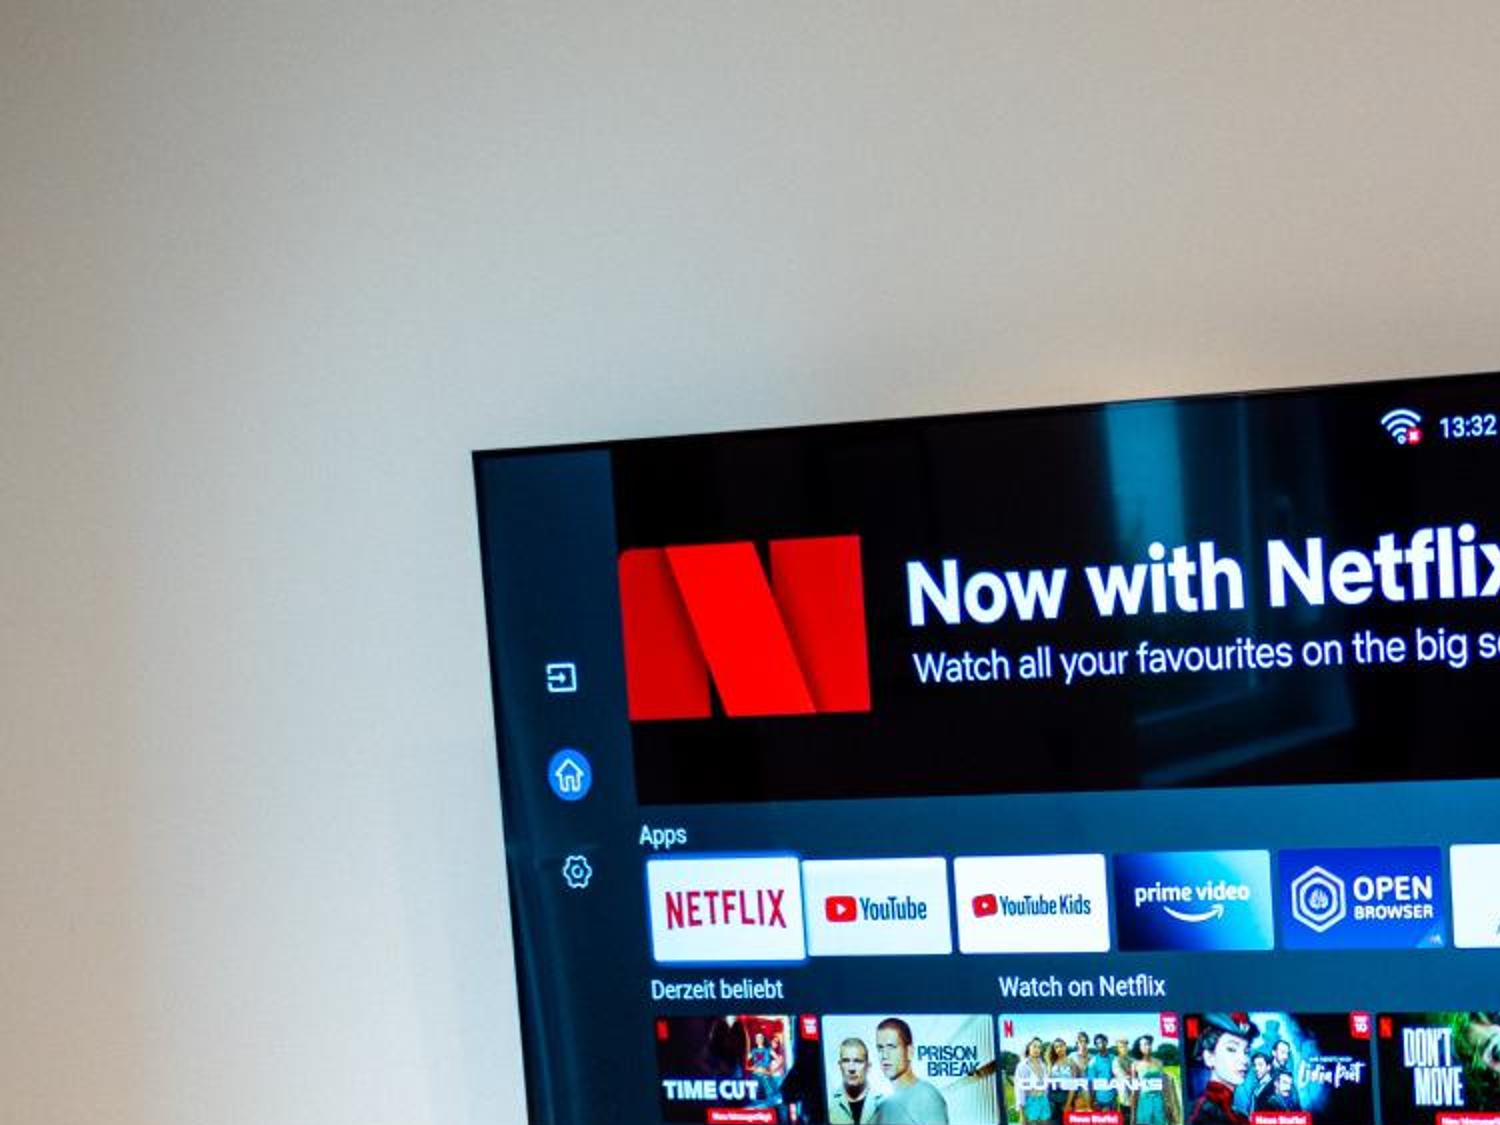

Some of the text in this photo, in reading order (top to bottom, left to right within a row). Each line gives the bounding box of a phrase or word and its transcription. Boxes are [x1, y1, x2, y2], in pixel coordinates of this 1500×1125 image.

[1440, 414, 1497, 439] 13:32
[906, 559, 1066, 627] Now
[1085, 541, 1245, 617] with
[912, 649, 1010, 683] Watch
[1018, 647, 1052, 679] all
[1060, 650, 1128, 685] your
[1136, 640, 1293, 674] favourites
[1302, 641, 1343, 666] on
[1352, 630, 1406, 663] the
[1415, 628, 1468, 668] big
[640, 825, 687, 848] Apps
[1134, 881, 1250, 907] prime video
[1353, 876, 1433, 901] OPEN
[665, 889, 788, 930] NETFLIX
[860, 896, 928, 921] YouTube
[1000, 893, 1091, 917] YouTube Kids
[1353, 904, 1434, 920] BROWSER
[651, 977, 785, 1000] Derzeit beliebt
[999, 974, 1166, 997] Watch on Netflix
[917, 1045, 978, 1061] PRISON
[1403, 1027, 1452, 1067] DON'T
[927, 1061, 979, 1077] BREAK
[663, 1079, 759, 1100] TIME CUT
[1414, 1066, 1465, 1106] MOVE
